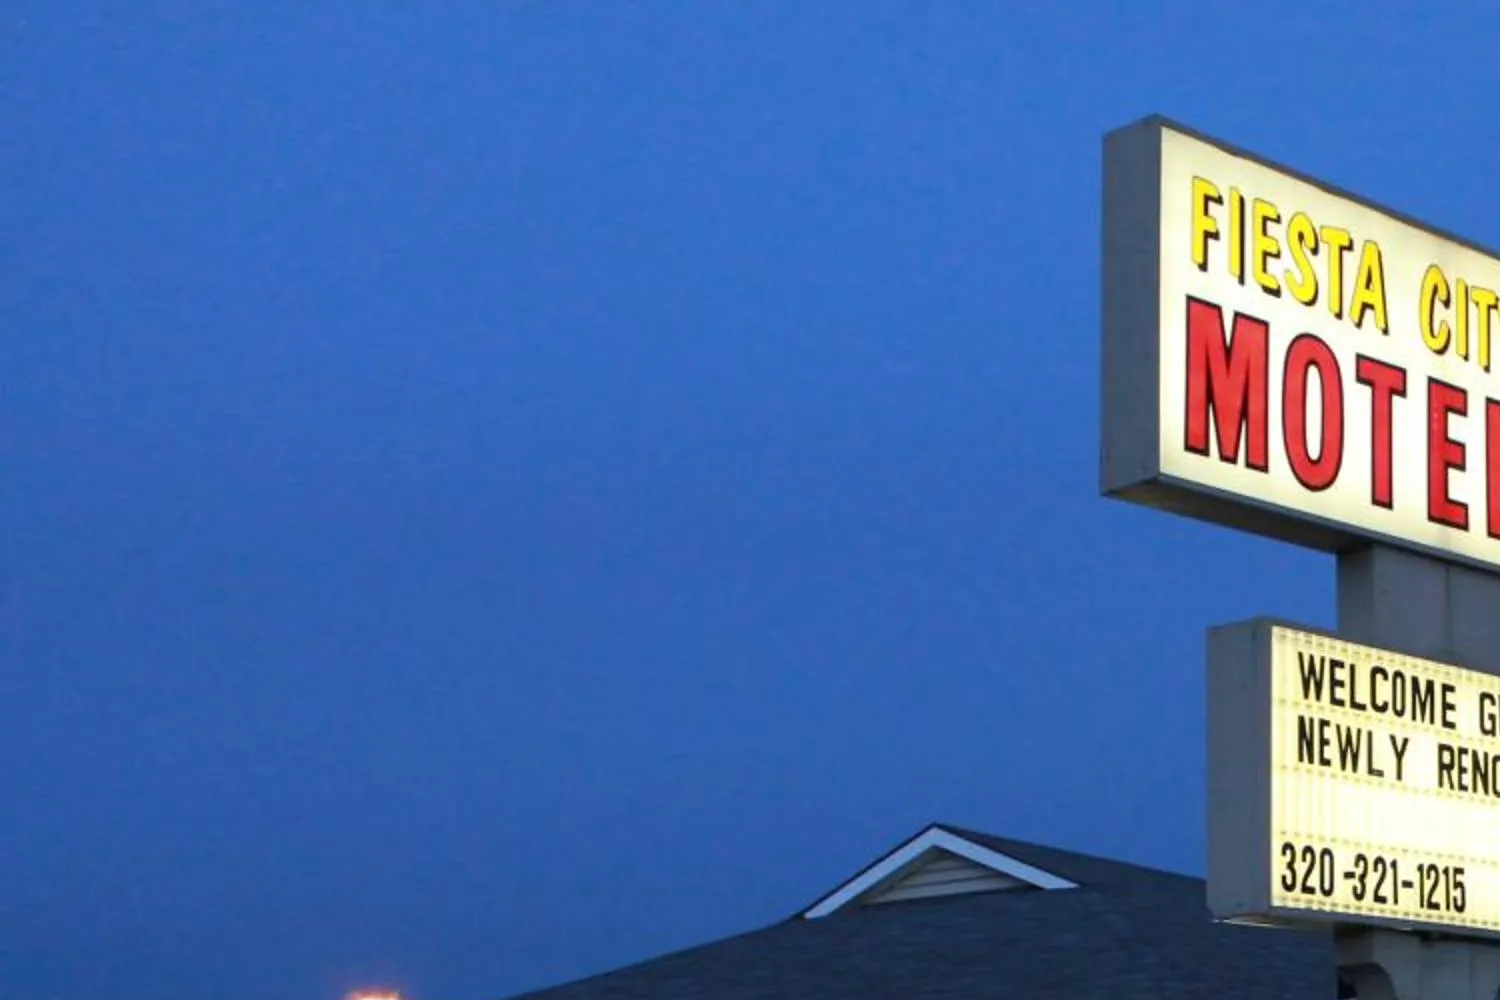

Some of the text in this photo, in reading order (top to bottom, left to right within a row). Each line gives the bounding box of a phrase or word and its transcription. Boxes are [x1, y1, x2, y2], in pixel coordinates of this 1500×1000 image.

[1190, 175, 1389, 335] FIESTA
[1297, 651, 1457, 730] WELCOME
[1298, 715, 1409, 781] NEWLY
